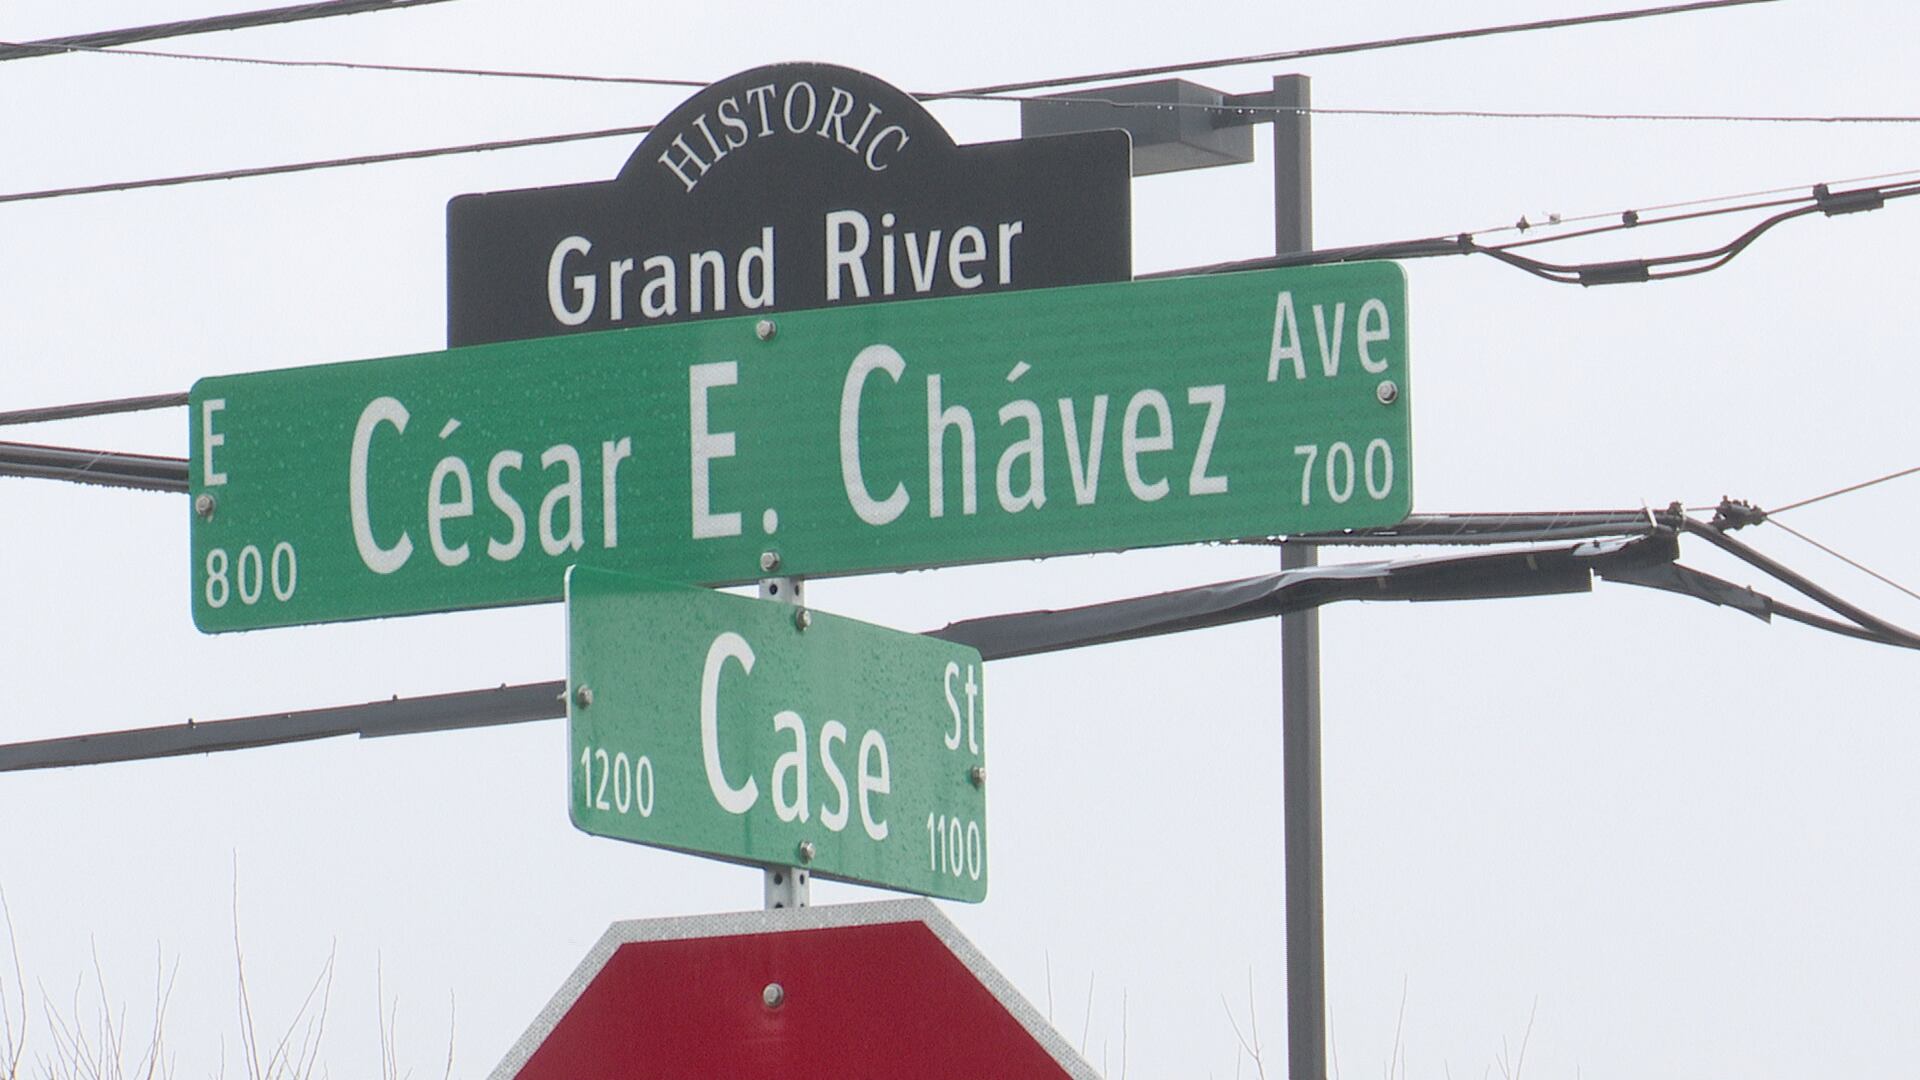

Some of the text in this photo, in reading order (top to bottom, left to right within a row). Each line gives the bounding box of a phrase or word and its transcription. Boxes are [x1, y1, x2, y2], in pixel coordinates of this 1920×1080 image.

[659, 82, 910, 193] HISTORIC
[548, 211, 1023, 326] Grand River
[1268, 290, 1391, 382] Ave
[203, 399, 228, 487] E
[350, 344, 1228, 575] César E. Chávez
[1294, 438, 1394, 506] 700
[205, 541, 297, 609] 800
[701, 631, 891, 841] Case
[944, 662, 979, 756] St
[580, 747, 654, 818] 1200
[926, 812, 982, 881] 1100
